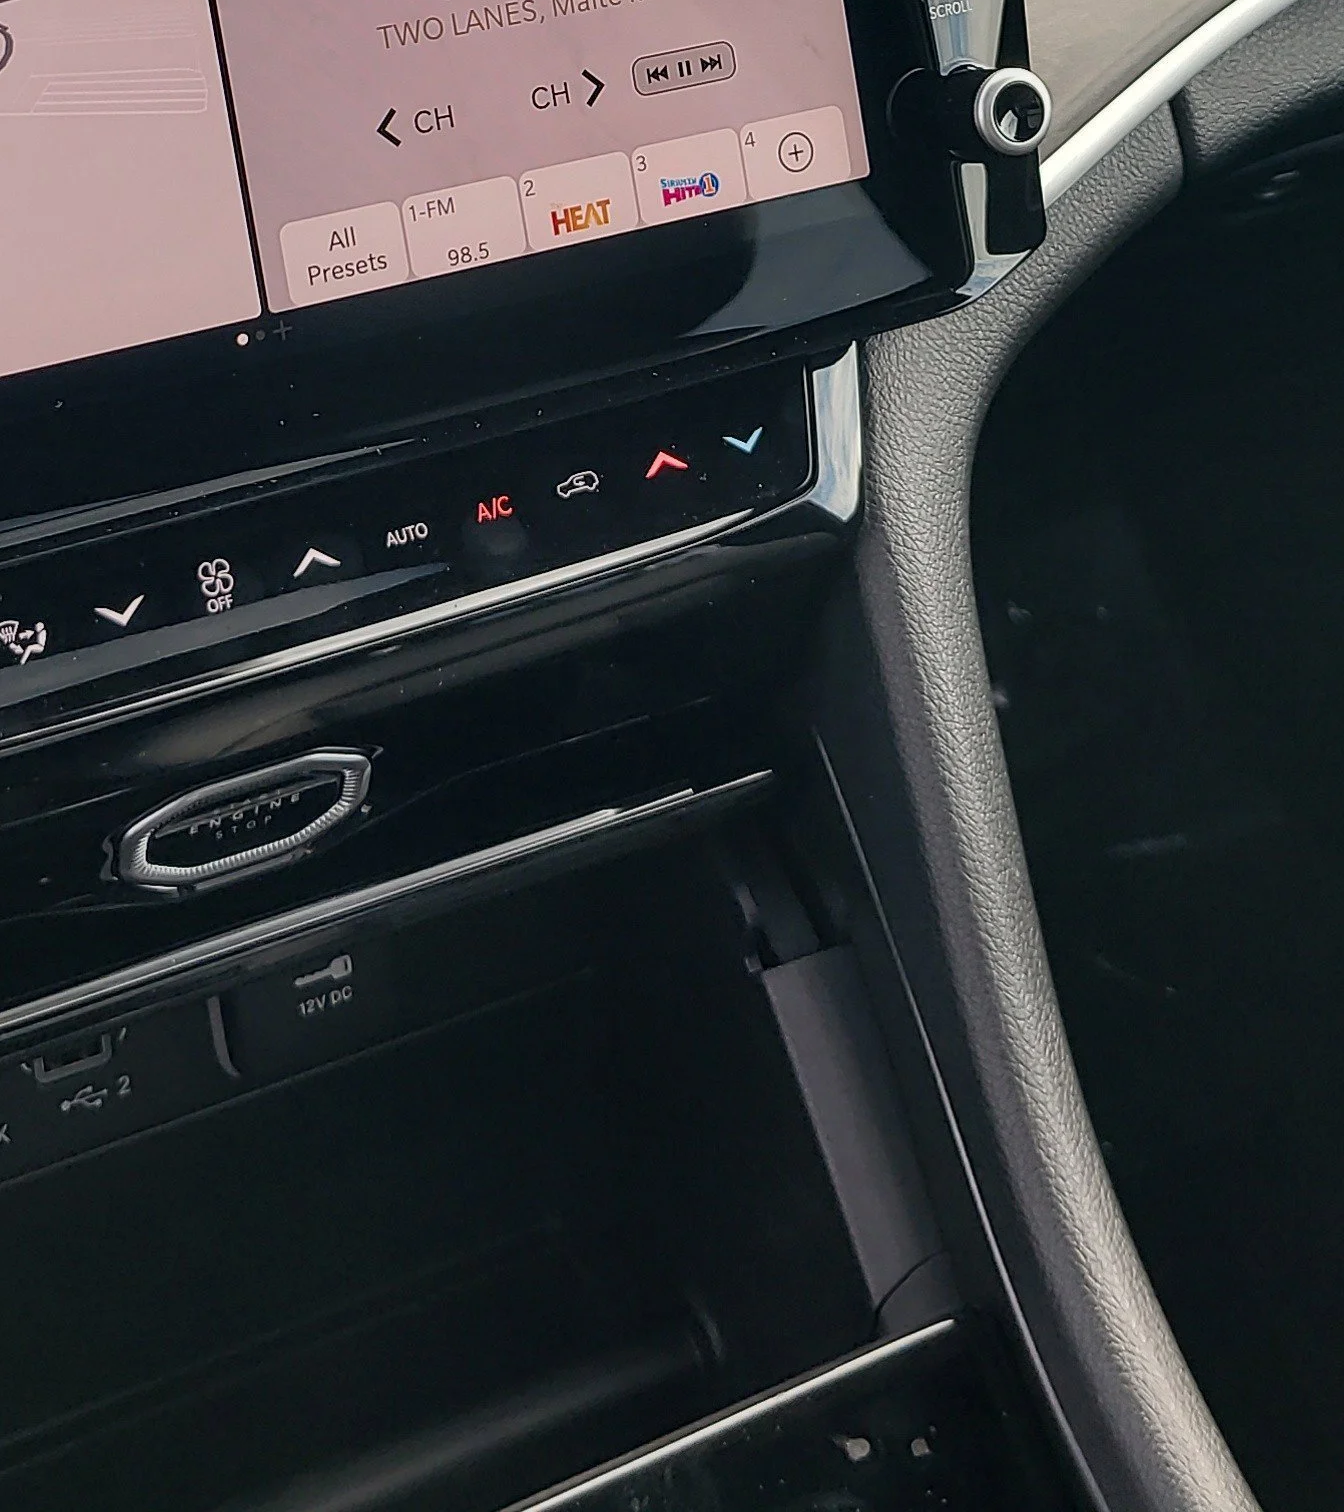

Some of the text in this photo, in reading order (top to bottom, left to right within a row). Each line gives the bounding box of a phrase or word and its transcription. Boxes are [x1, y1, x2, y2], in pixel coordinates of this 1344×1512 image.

[929, 0, 973, 20] SCROLL
[377, 17, 444, 50] TWO
[531, 82, 571, 110] CH
[414, 105, 455, 135] CH
[744, 131, 756, 149] 4
[636, 155, 647, 172] 3
[523, 179, 536, 197] 2
[408, 196, 455, 223] 1-FM
[551, 198, 610, 236] HEAT
[329, 226, 357, 253] All
[306, 250, 388, 286] Presets
[447, 242, 490, 267] 98.5
[476, 495, 513, 523] A/C
[386, 522, 429, 549] AUTO
[206, 593, 234, 614] OFF
[189, 792, 300, 835] ENGINE
[215, 815, 272, 839] STOP
[298, 984, 354, 1017] 12V DC
[117, 1075, 133, 1096] 2
